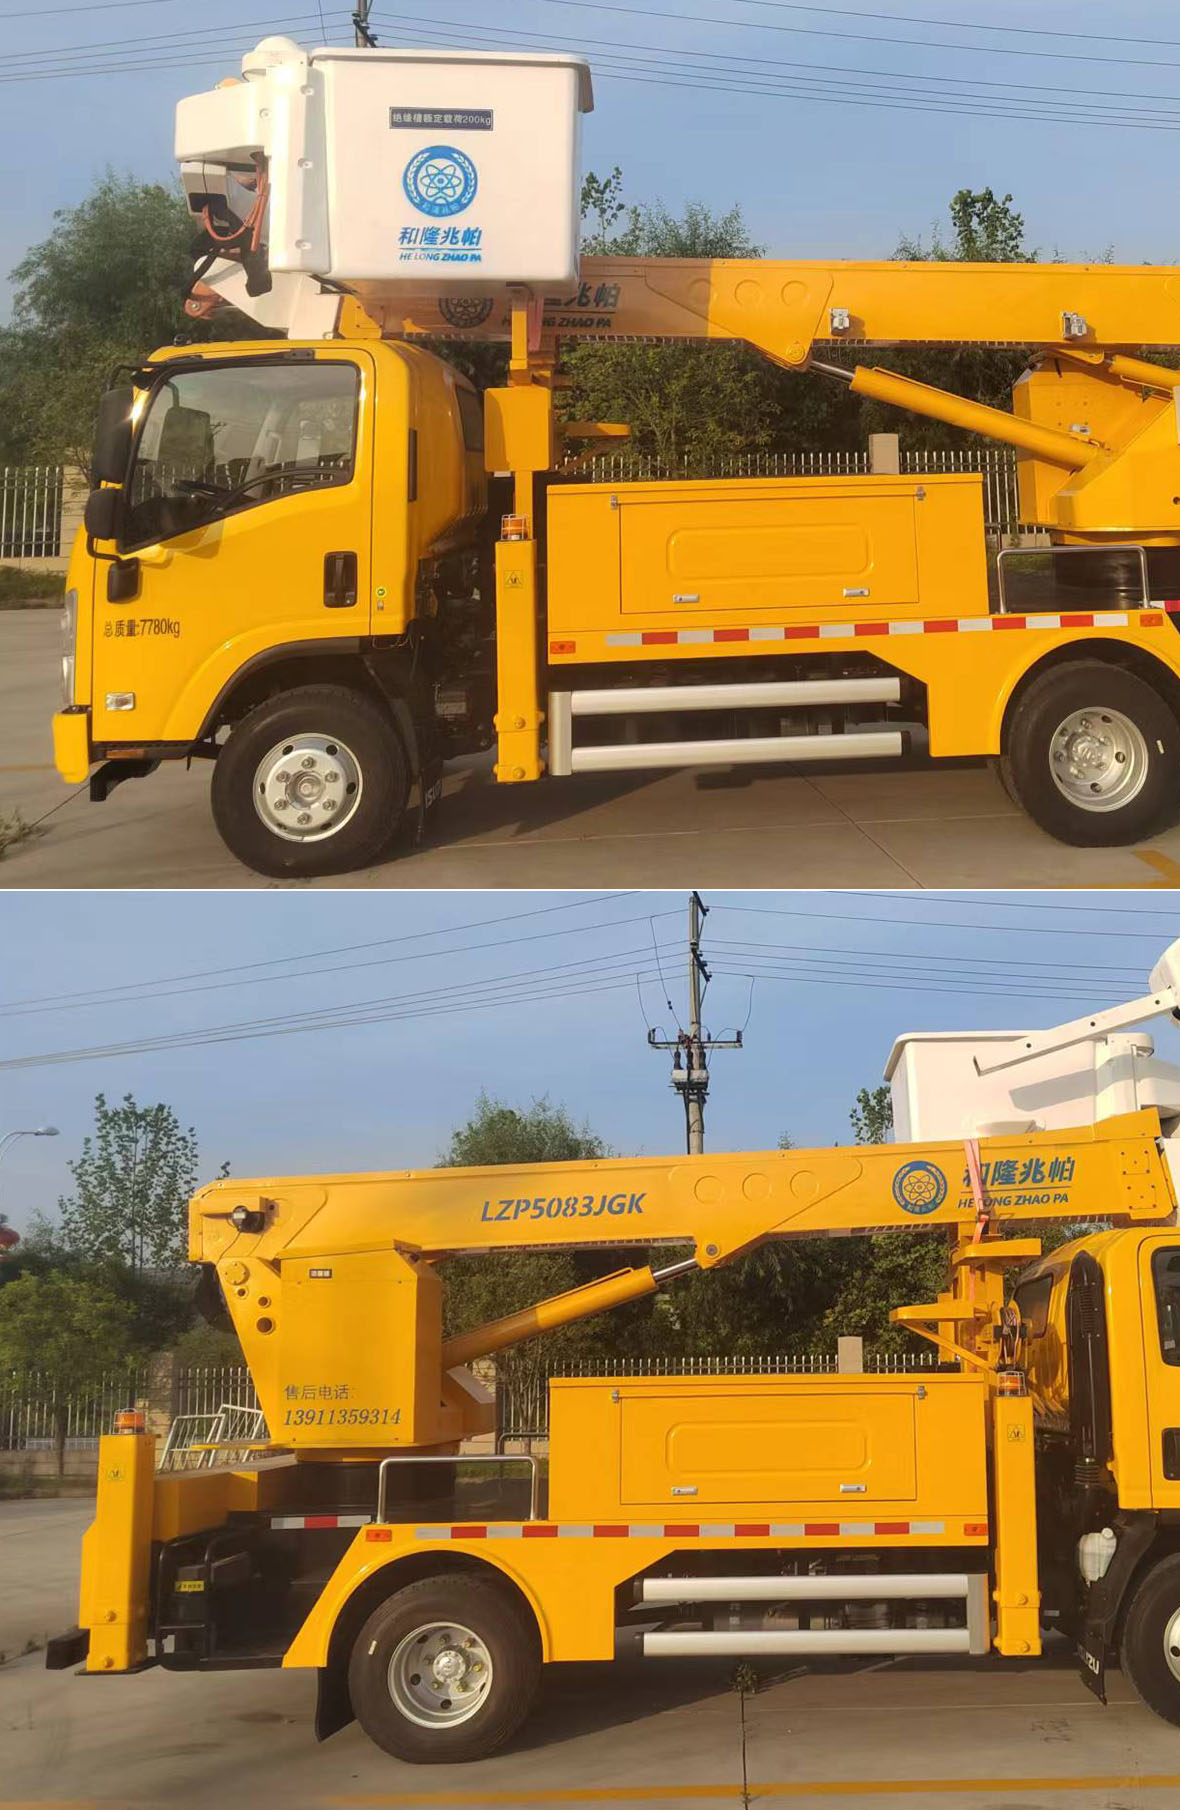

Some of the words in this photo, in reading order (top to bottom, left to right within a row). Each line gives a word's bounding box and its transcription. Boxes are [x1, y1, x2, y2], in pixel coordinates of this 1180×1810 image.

[398, 225, 482, 247] 和隆兆帕
[399, 252, 412, 261] HE
[595, 317, 612, 328] PA
[104, 618, 181, 639] 总质量:7780kg
[480, 1192, 647, 1223] LZP5083JGK
[977, 1195, 1012, 1207] ONG
[1014, 1193, 1051, 1206] ZHAO
[1053, 1192, 1069, 1204] PA
[283, 1408, 402, 1426] 13911359314
